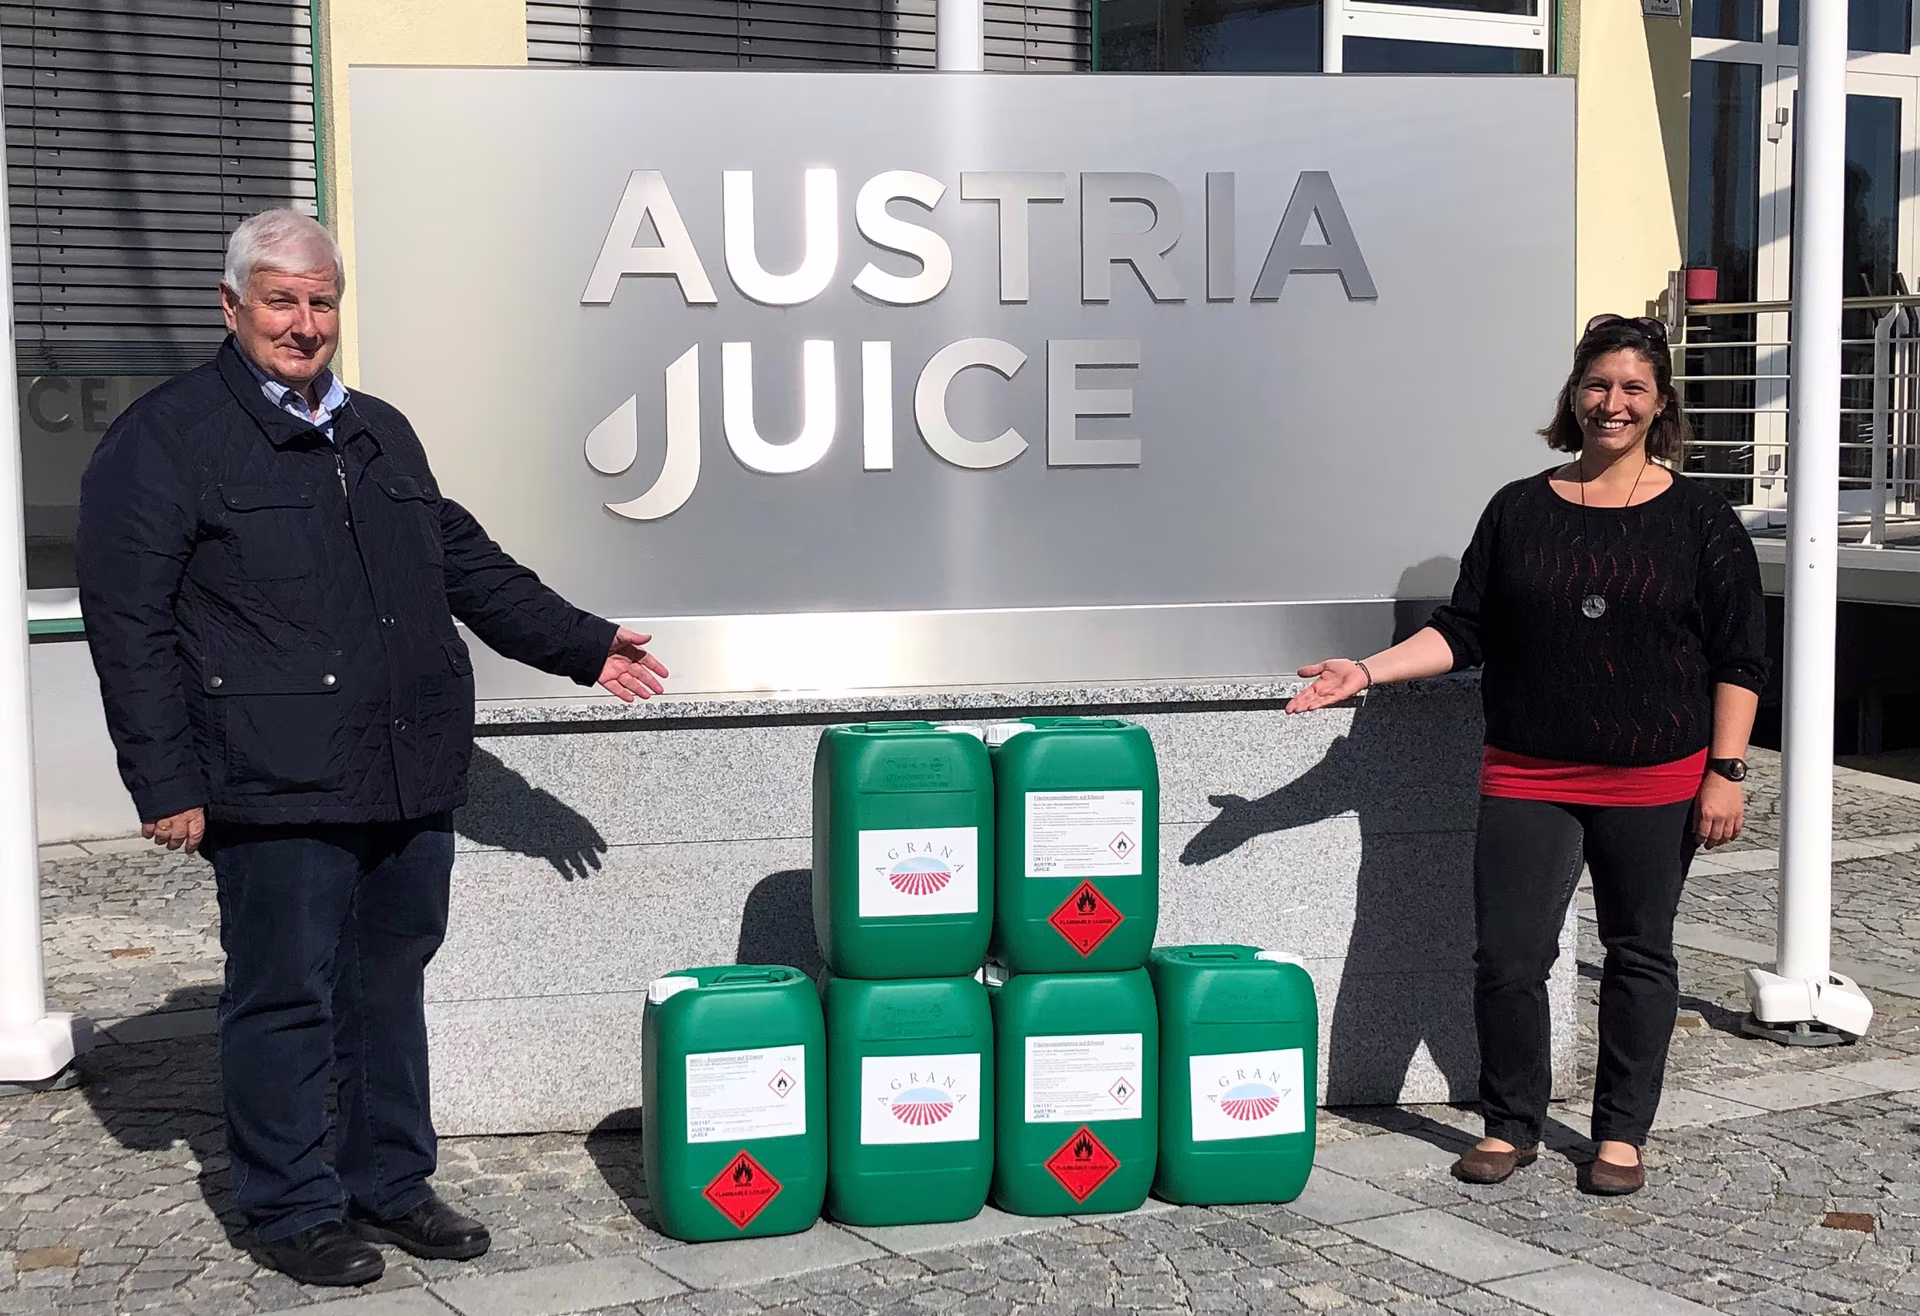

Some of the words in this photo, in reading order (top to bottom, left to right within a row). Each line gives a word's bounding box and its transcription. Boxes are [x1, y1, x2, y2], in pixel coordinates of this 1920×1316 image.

[580, 168, 1378, 306] AUSTRIA
[584, 337, 1141, 520] JUICE
[875, 841, 964, 876] AGRANA
[878, 1072, 967, 1106] AGRANA
[1207, 1068, 1292, 1103] AGRANA
